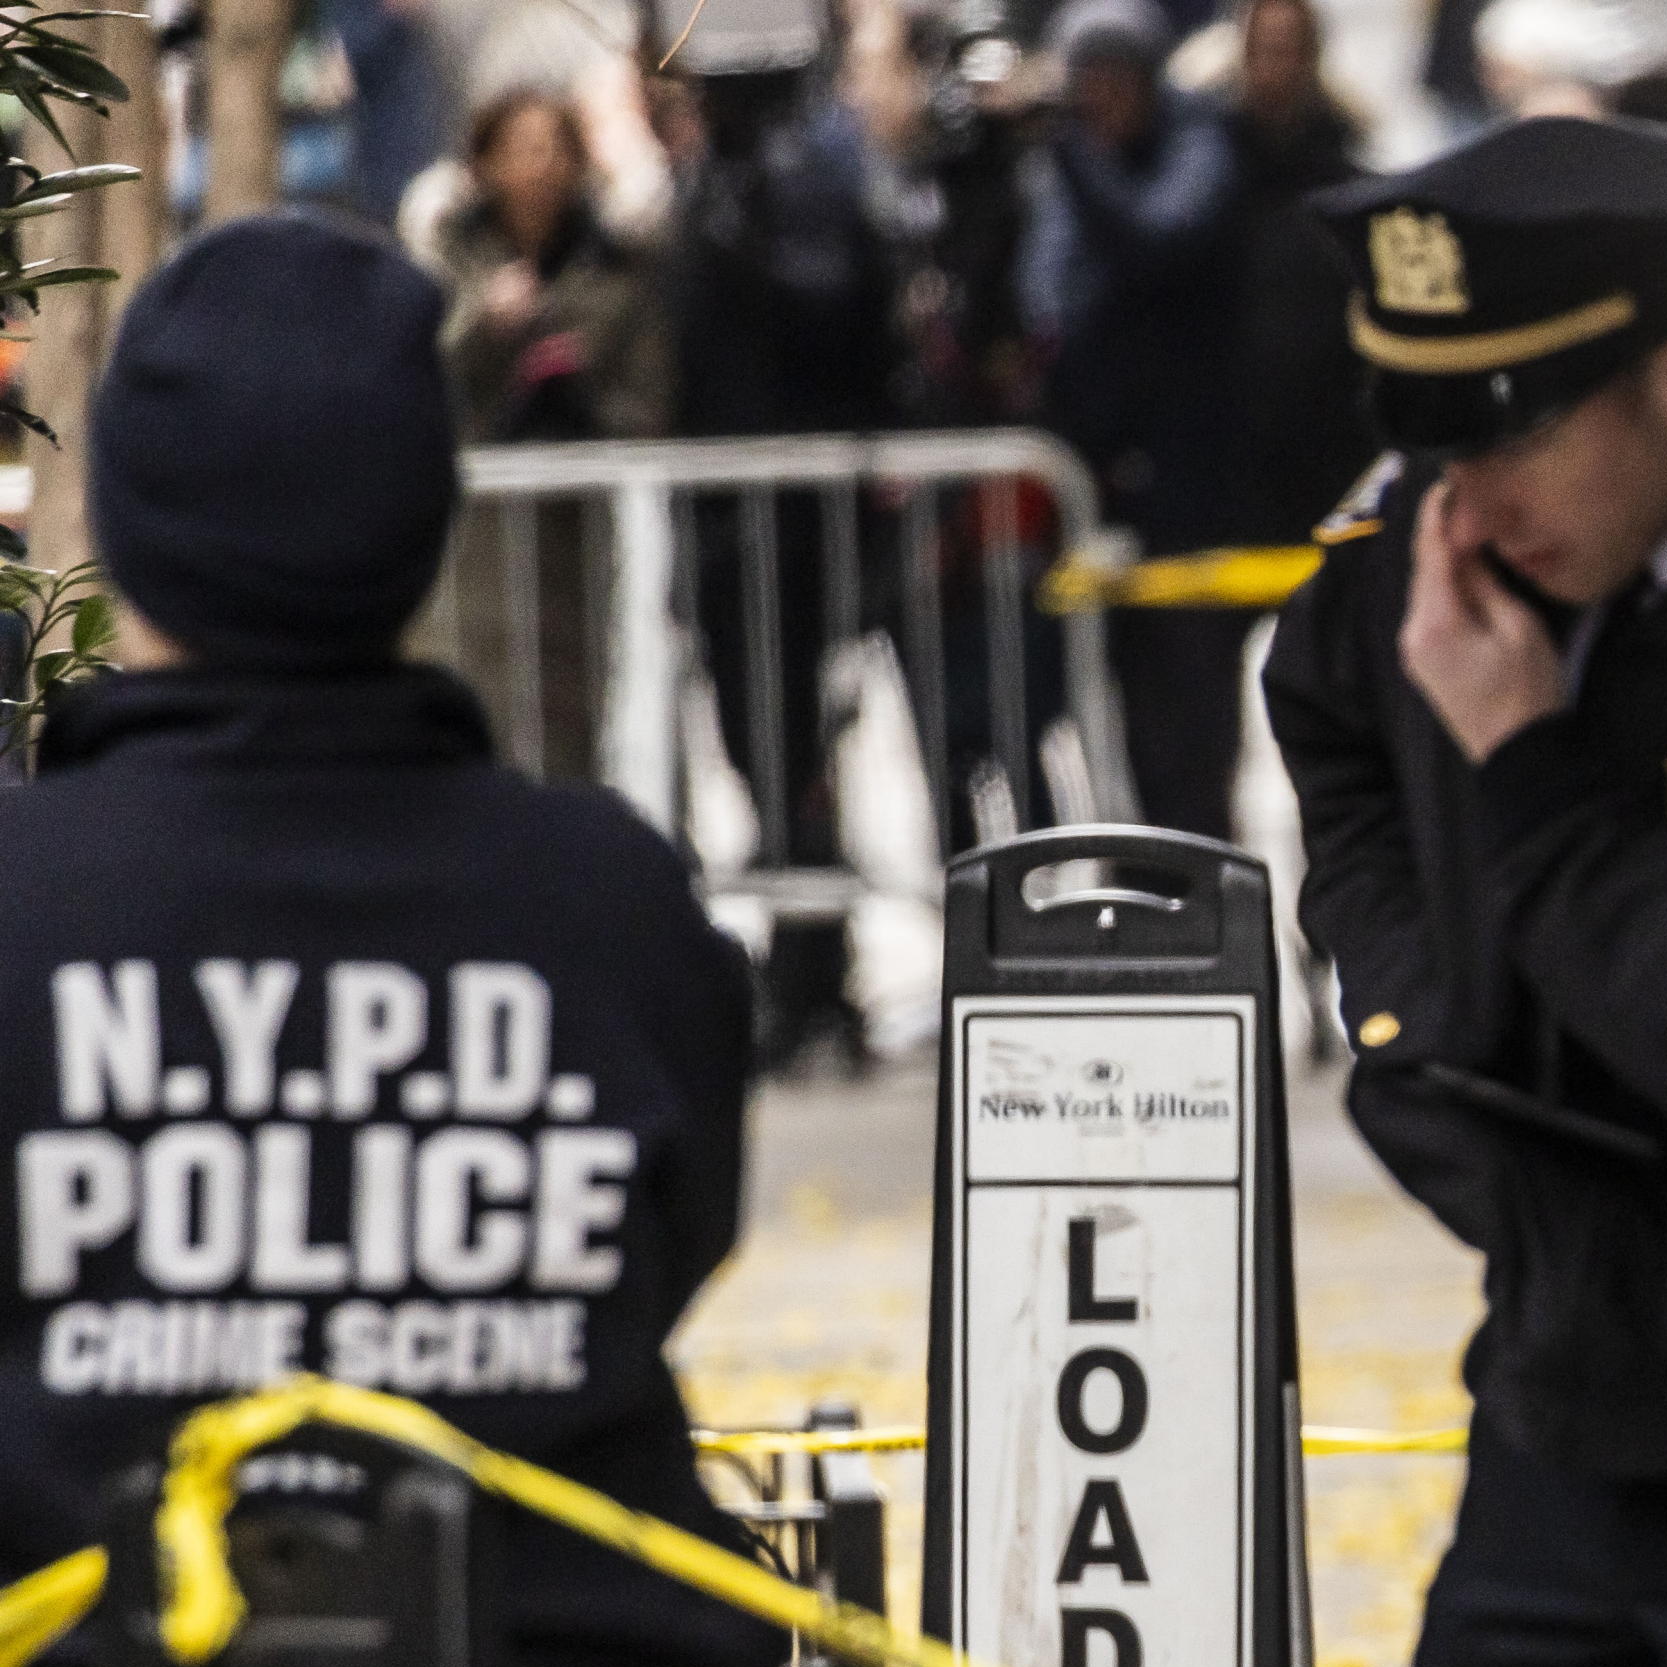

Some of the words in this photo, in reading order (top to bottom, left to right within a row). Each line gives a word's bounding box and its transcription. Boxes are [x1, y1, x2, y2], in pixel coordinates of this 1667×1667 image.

[50, 960, 597, 1122] N.Y.P.D.
[979, 1093, 1046, 1121] New
[1054, 1092, 1123, 1120] York
[1133, 1091, 1230, 1119] Hilton
[14, 1122, 638, 1299] POLICE
[40, 1300, 308, 1393] CRIME
[321, 1300, 590, 1393] SCENE
